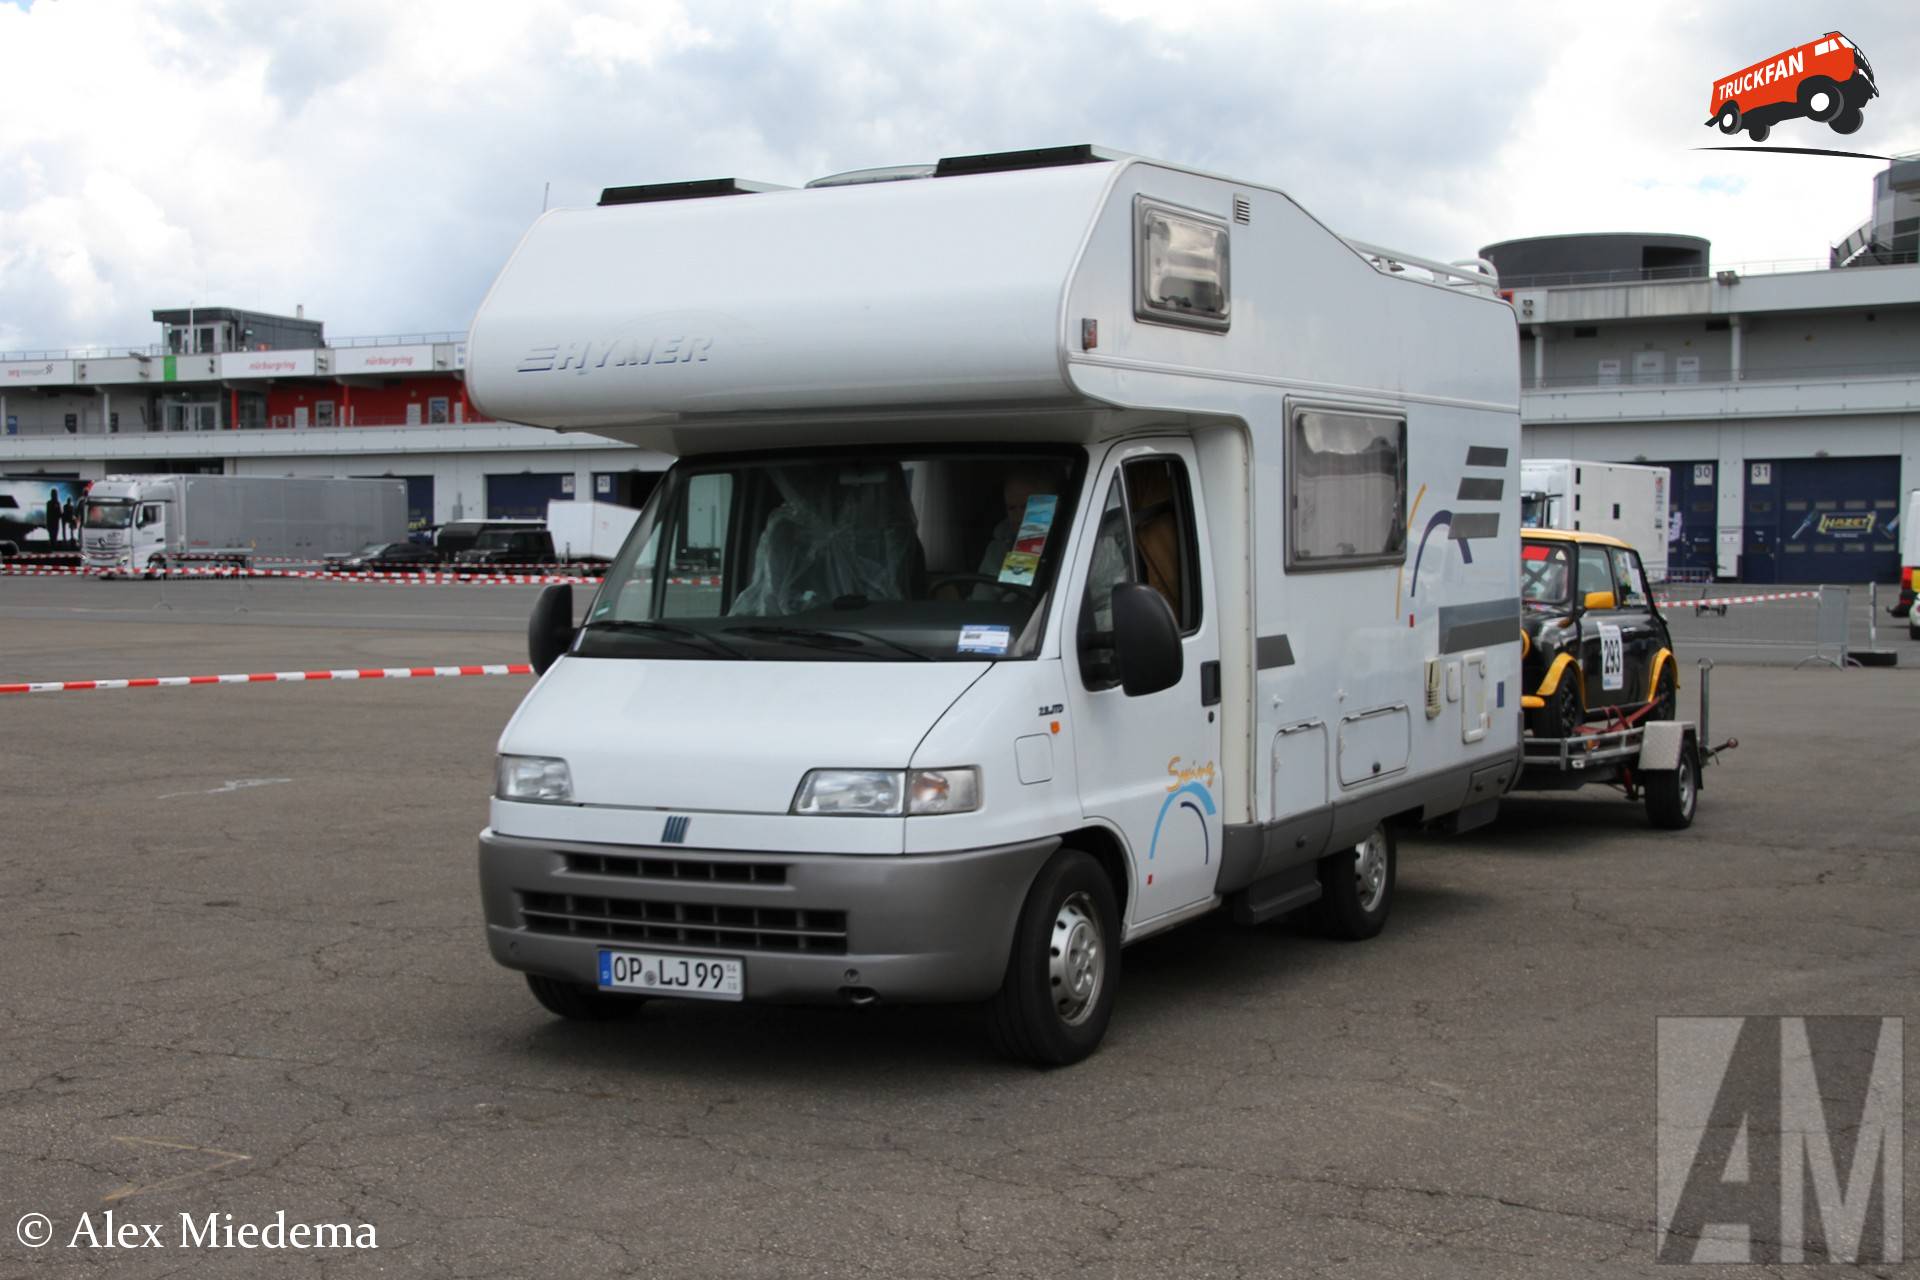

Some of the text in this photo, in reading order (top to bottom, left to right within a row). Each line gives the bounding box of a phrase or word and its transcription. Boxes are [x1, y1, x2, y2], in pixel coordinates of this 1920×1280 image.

[1695, 466, 1711, 478] 30
[1753, 466, 1769, 478] 31
[1824, 517, 1868, 529] HAZET
[1604, 639, 1620, 674] 293
[1166, 755, 1216, 792] Swing
[614, 956, 643, 983] OP
